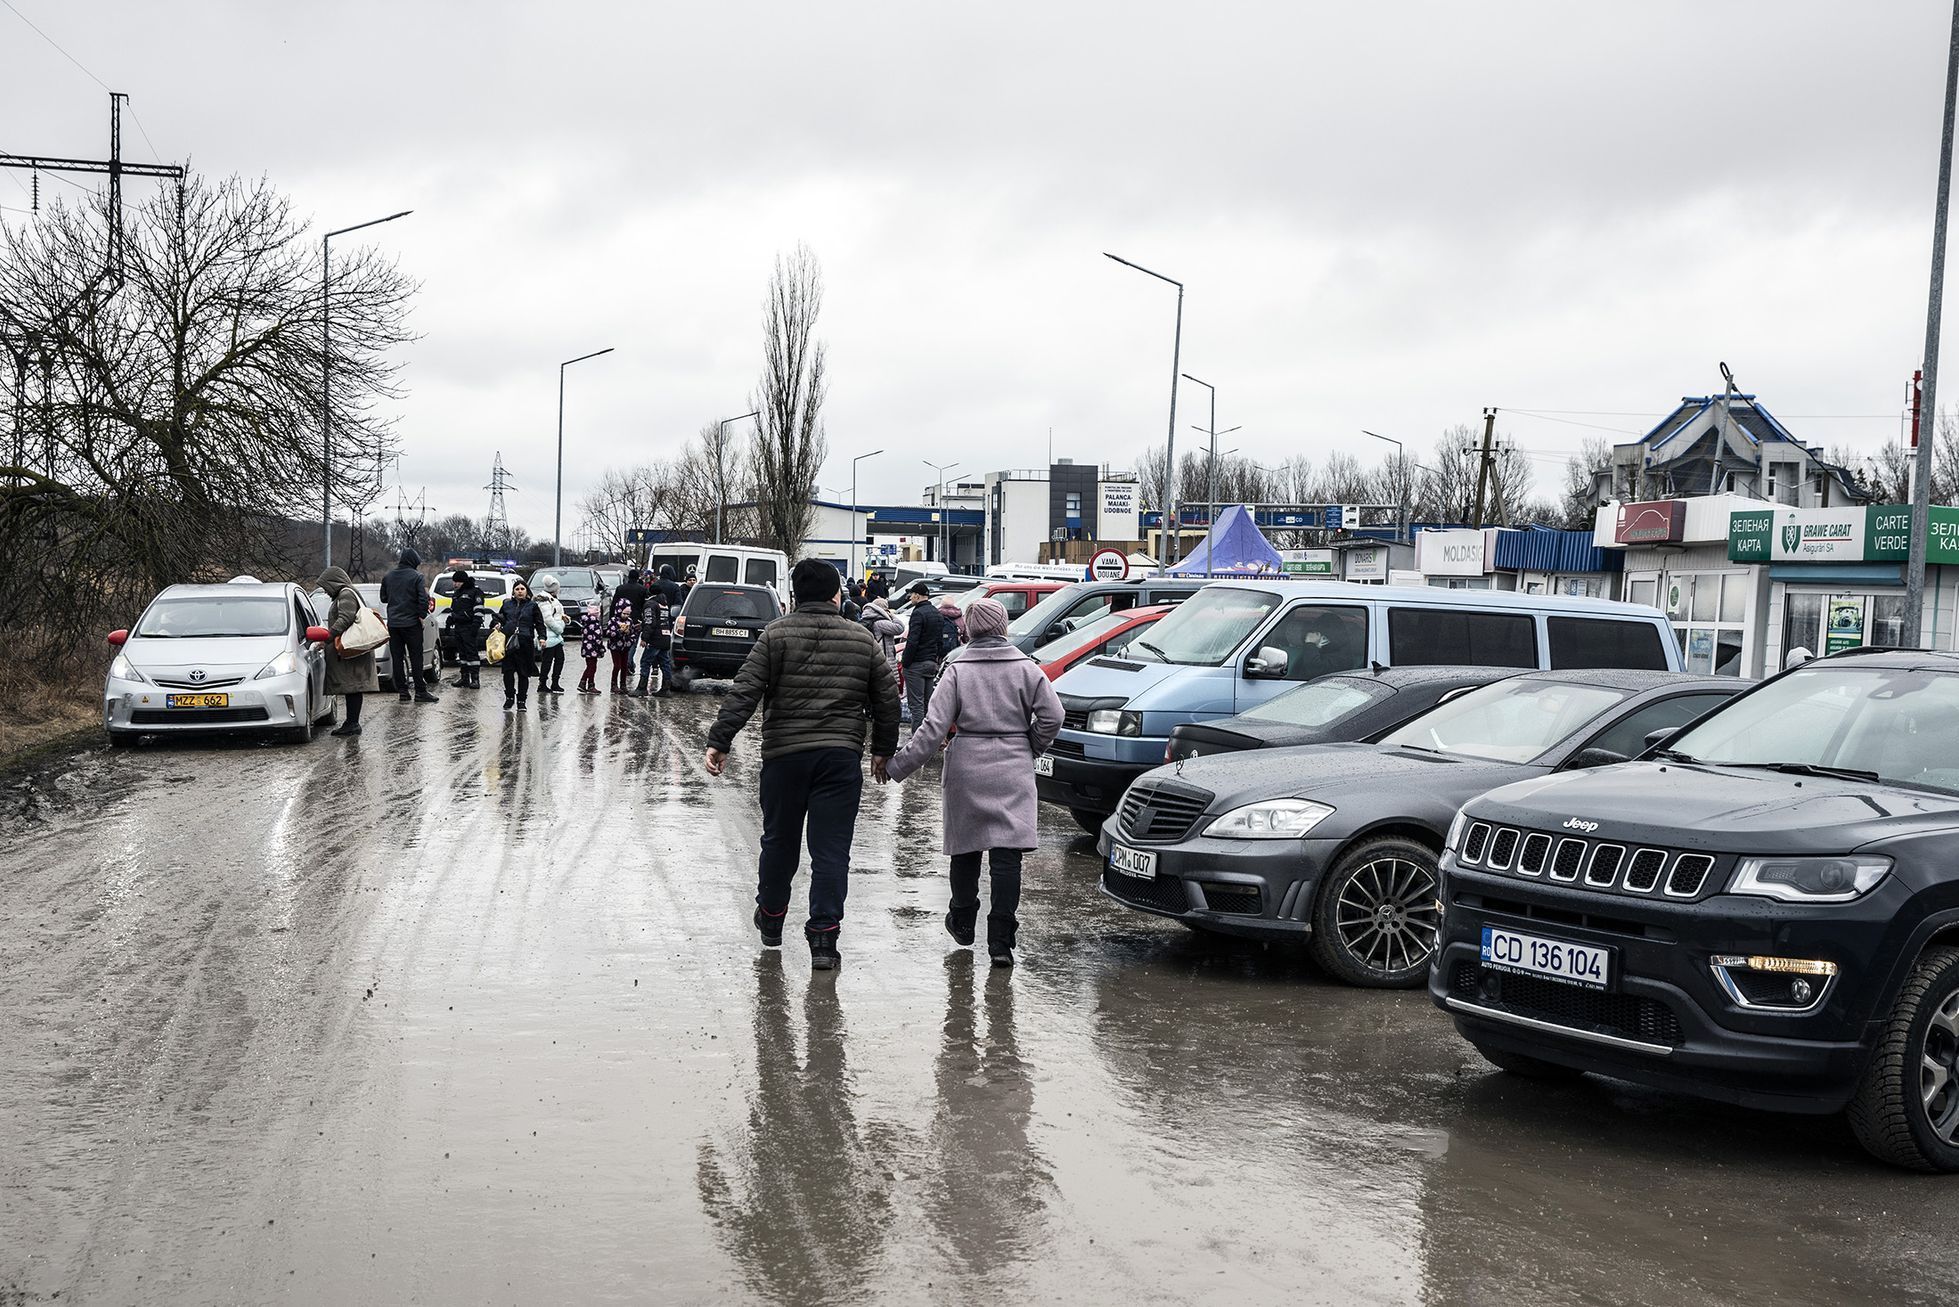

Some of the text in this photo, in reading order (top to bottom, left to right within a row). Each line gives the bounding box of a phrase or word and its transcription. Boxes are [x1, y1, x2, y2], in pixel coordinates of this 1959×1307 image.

[1732, 519, 1769, 533] ЗЕЛЕНАЯ
[1876, 515, 1909, 530] CARTE
[1804, 524, 1852, 537] GRAWE CARAT
[1737, 539, 1761, 552] КАРТА
[1826, 544, 1834, 552] SA
[1874, 535, 1908, 550] VERDE
[1940, 537, 1959, 550] КА
[1443, 545, 1482, 562] MOLDASIG
[1097, 571, 1121, 579] DOUANE
[175, 696, 222, 706] MZZ 662
[1563, 817, 1599, 833] Jeep
[1133, 852, 1151, 873] 007
[1482, 945, 1491, 956] RO
[1494, 934, 1523, 963] CD
[1530, 940, 1563, 971] 136
[1567, 948, 1602, 980] 104
[1481, 961, 1493, 969] AUTO
